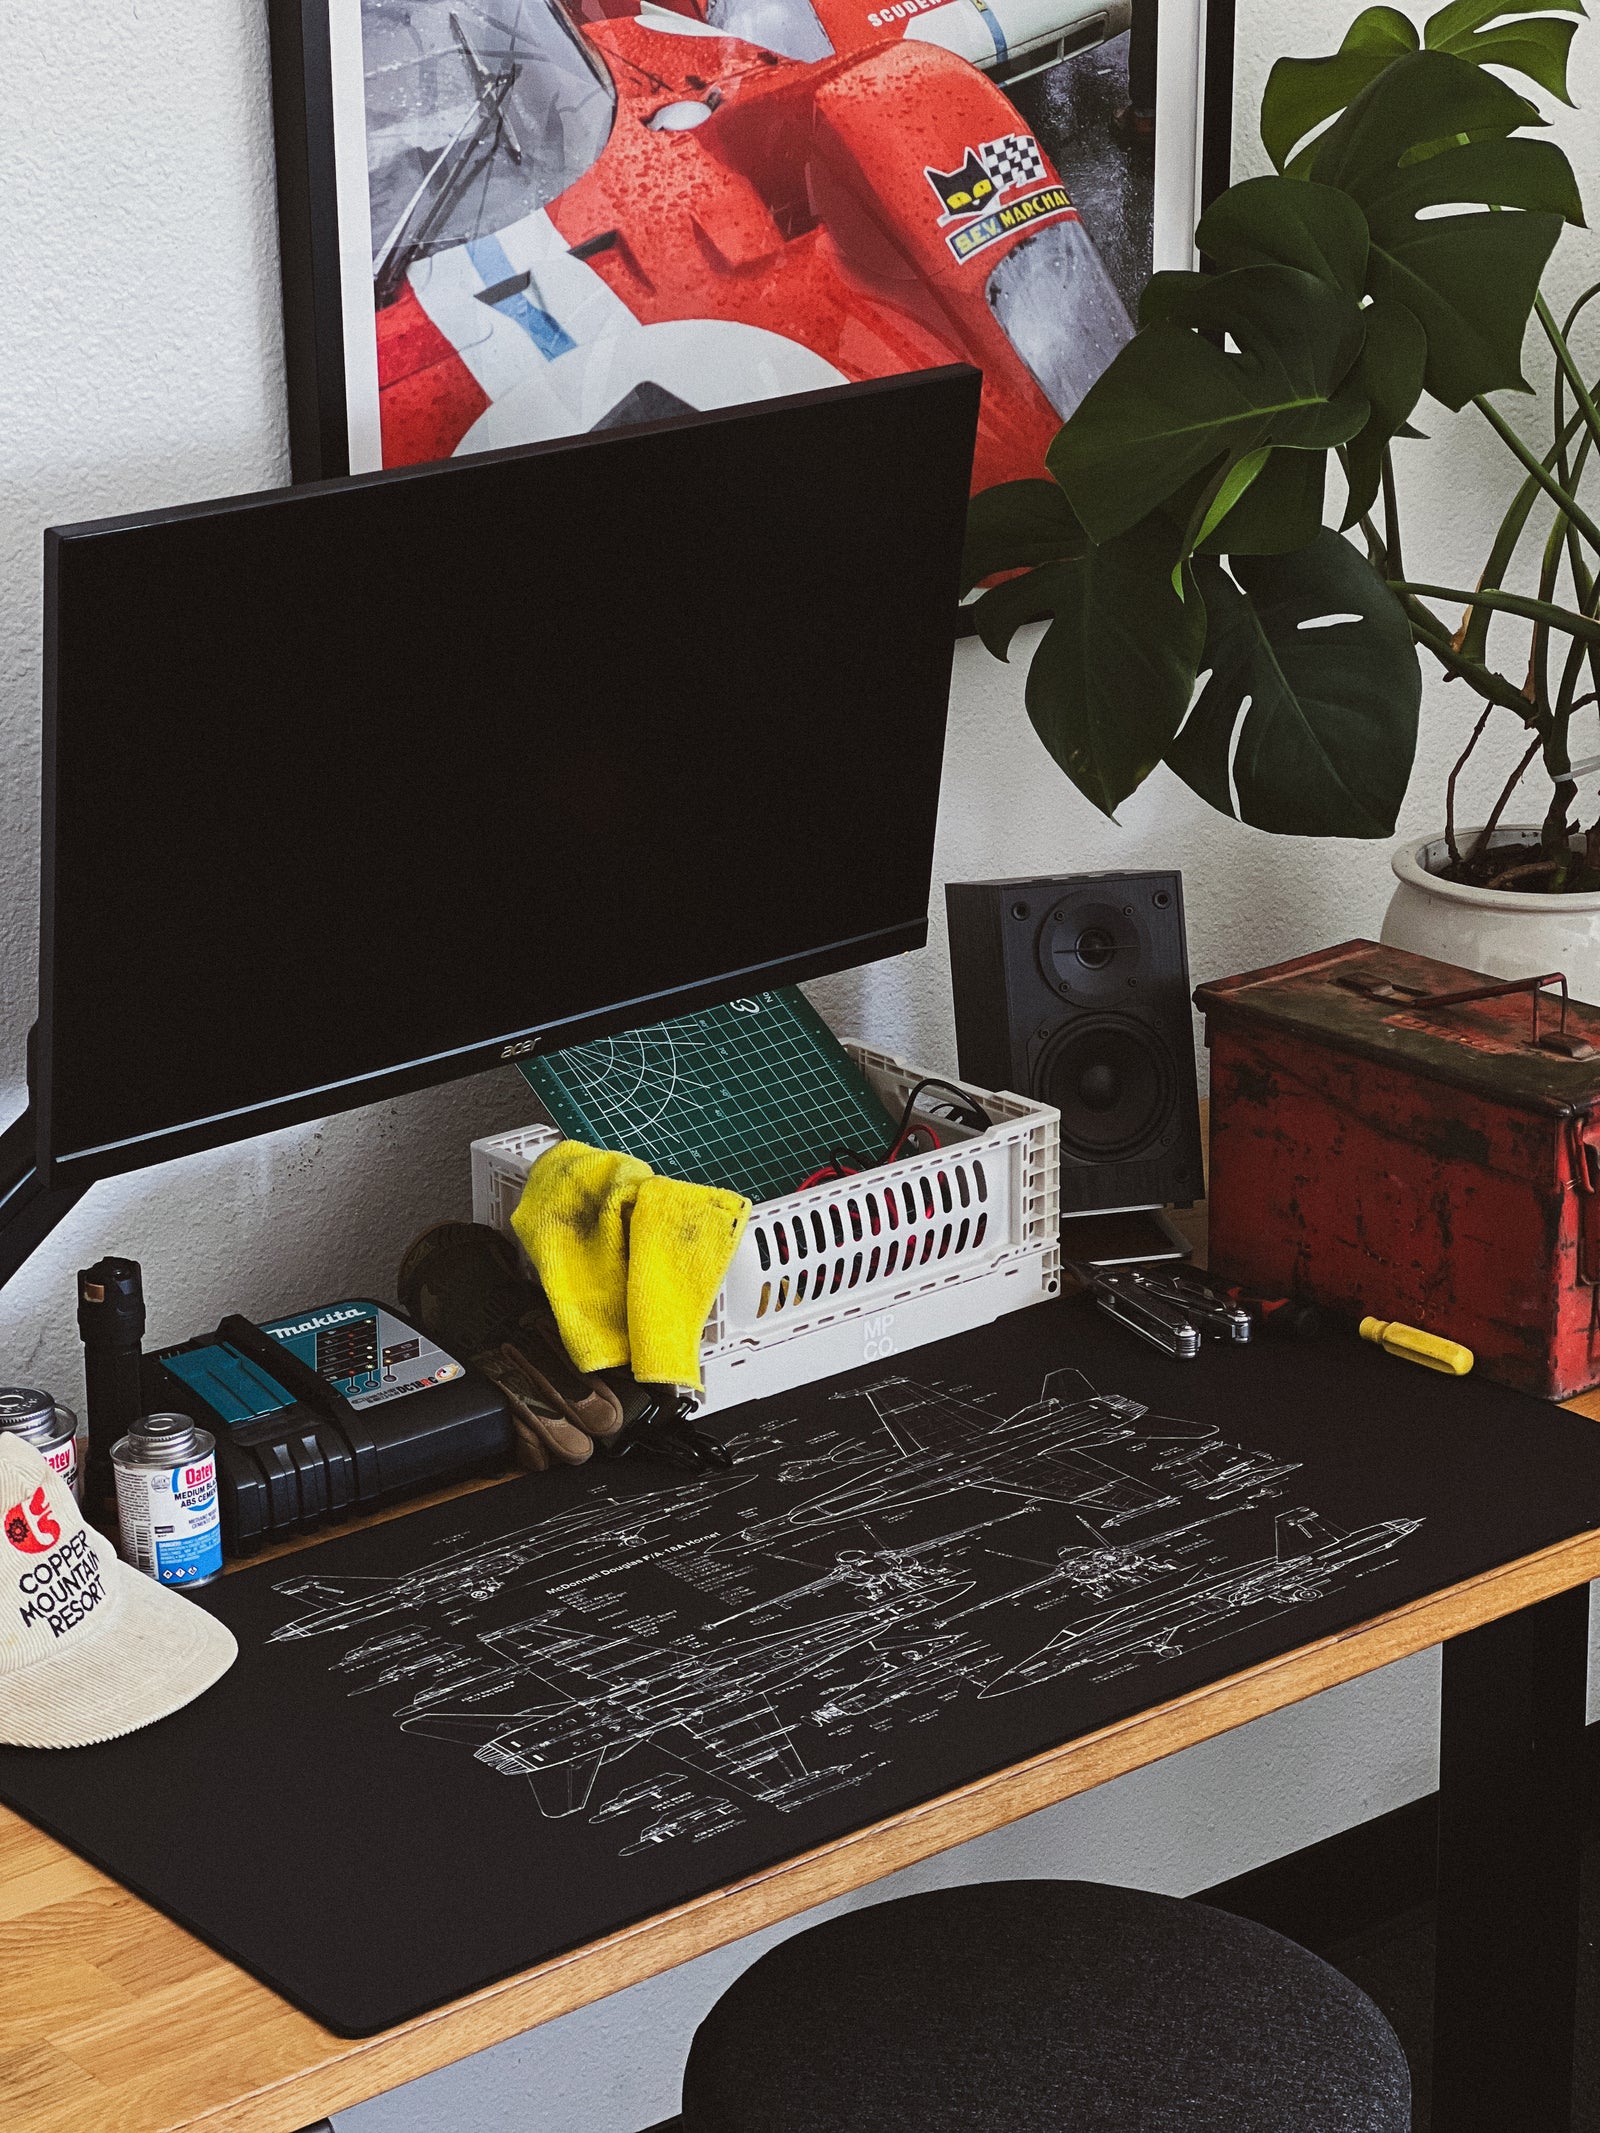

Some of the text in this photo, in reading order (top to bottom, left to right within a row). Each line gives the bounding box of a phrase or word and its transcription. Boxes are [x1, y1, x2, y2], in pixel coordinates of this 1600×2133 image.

[1000, 190, 1071, 228] MARCHAL
[501, 1037, 542, 1058] acer
[864, 1314, 894, 1340] MP
[863, 1336, 899, 1361] CO.
[44, 1449, 70, 1471] atey
[185, 1462, 213, 1486] Oatey
[174, 1479, 217, 1501] MEDIUM BLA
[181, 1489, 217, 1508] ABS CEMEN
[19, 1529, 90, 1594] COPPER
[545, 1573, 601, 1596] McDonnell
[600, 1559, 644, 1577] Douglas
[643, 1542, 687, 1562] F/A-18A
[685, 1531, 721, 1547] Hornet
[19, 1550, 100, 1628] MOUNTAIN
[47, 1574, 106, 1638] RESORT
